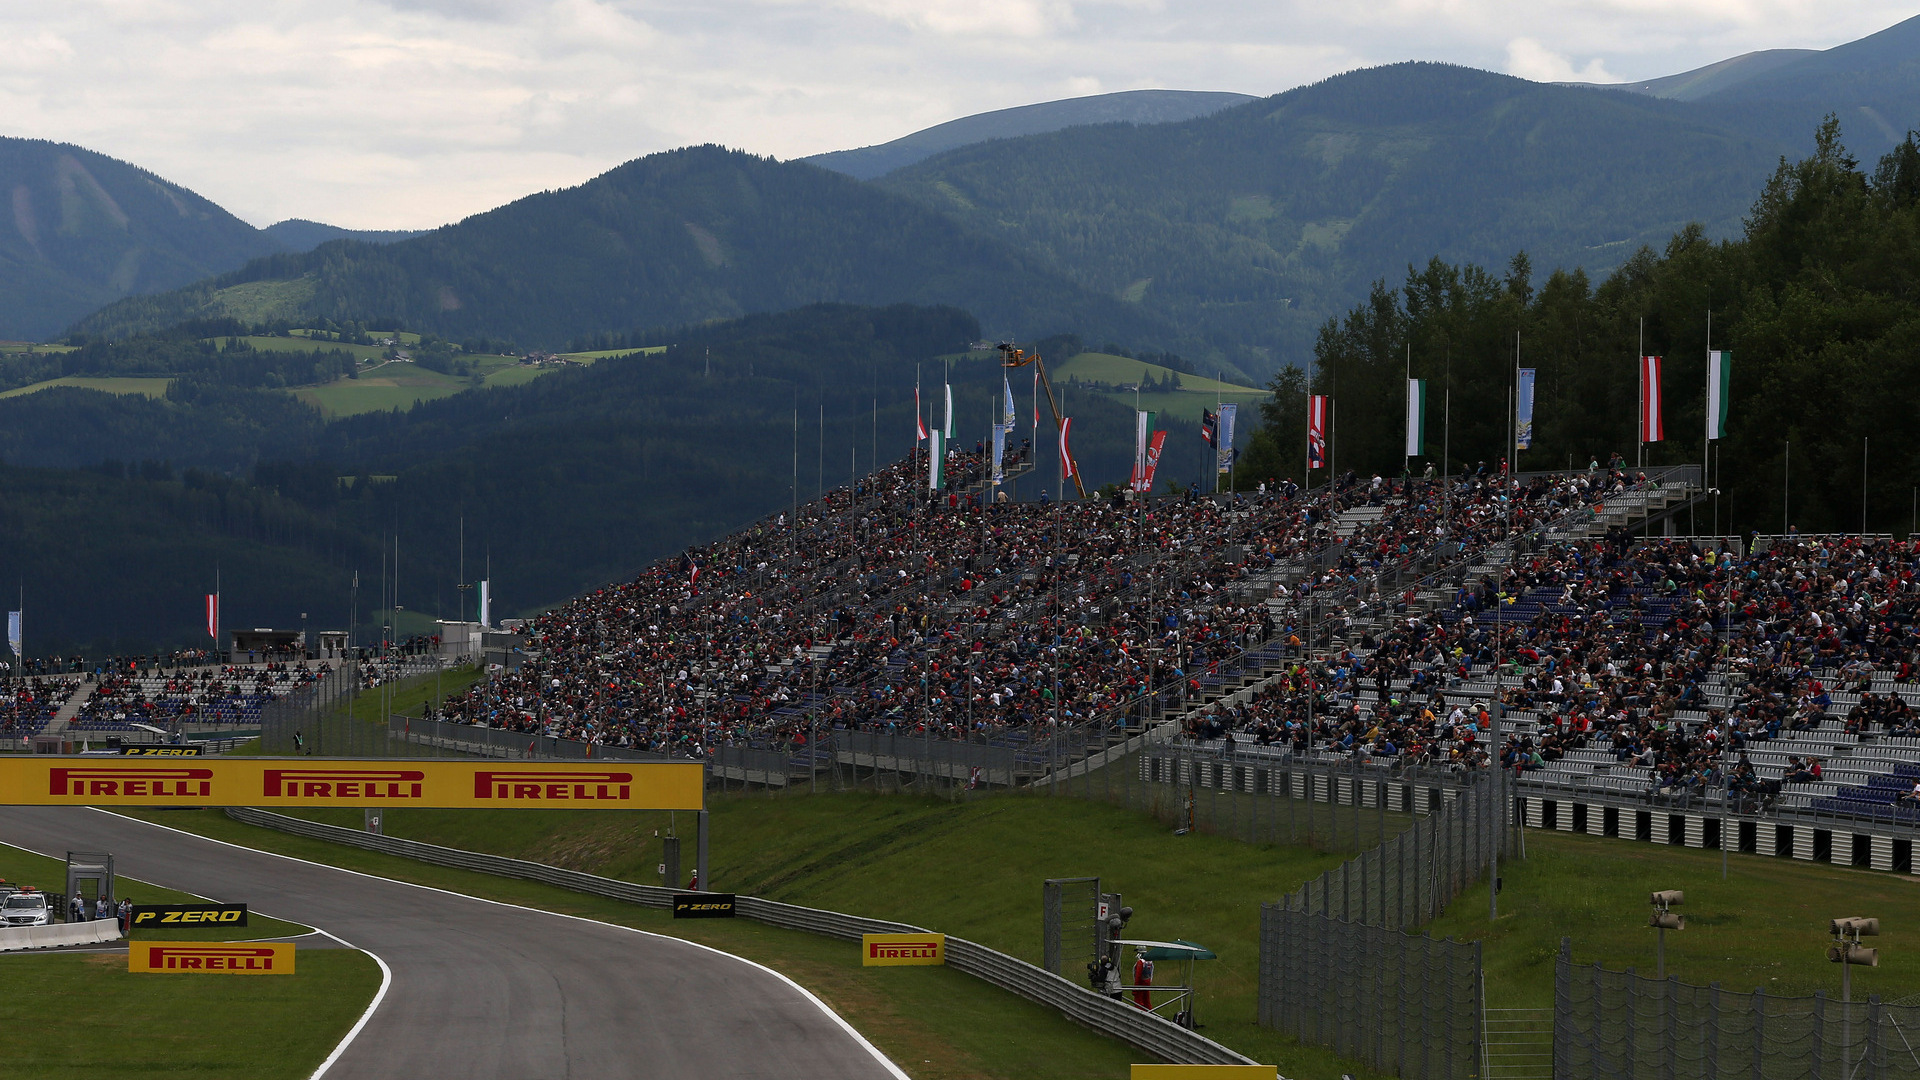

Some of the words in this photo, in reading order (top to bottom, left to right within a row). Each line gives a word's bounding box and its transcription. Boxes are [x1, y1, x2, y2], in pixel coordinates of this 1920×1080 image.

[125, 748, 140, 756] P
[143, 748, 198, 756] ZERO
[50, 768, 213, 796] PIRELLI
[264, 769, 424, 798] PIRELLI
[475, 772, 632, 800] PIRELLI
[135, 912, 156, 923] P
[161, 911, 241, 923] ZERO
[1100, 906, 1107, 917] F
[149, 947, 274, 970] PIRELLI
[870, 943, 938, 958] PIRELLI
